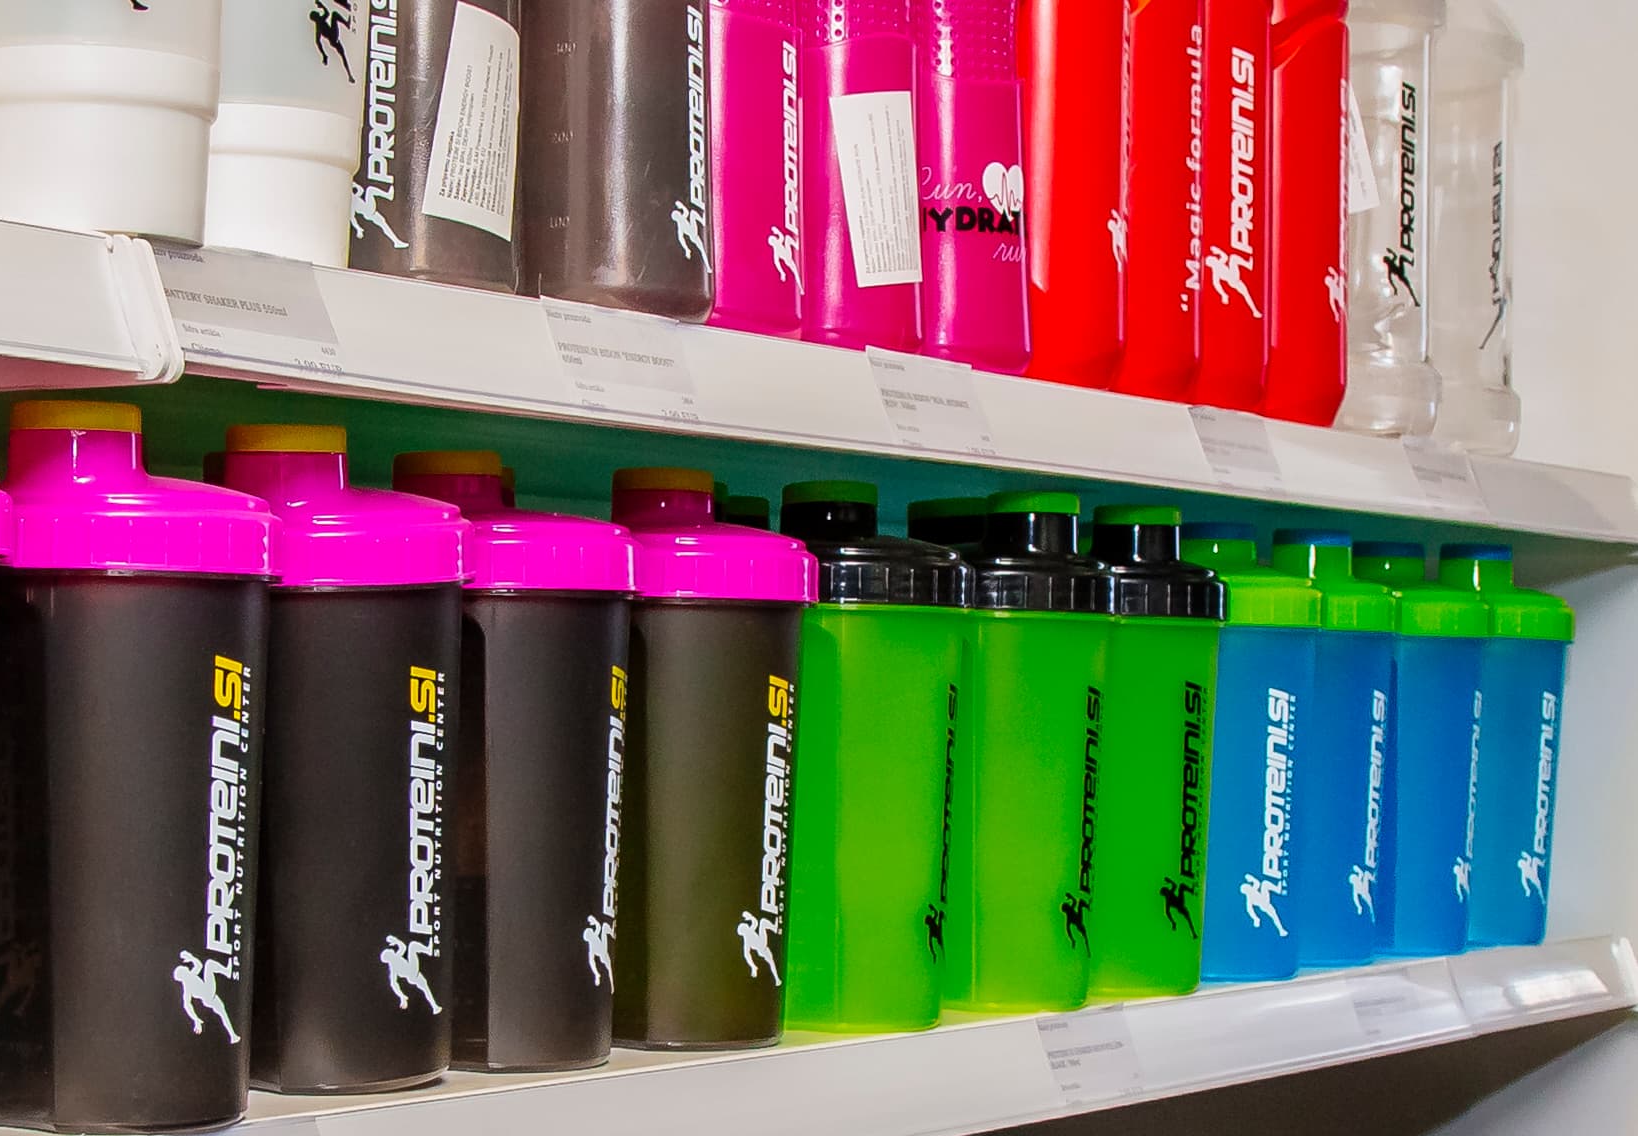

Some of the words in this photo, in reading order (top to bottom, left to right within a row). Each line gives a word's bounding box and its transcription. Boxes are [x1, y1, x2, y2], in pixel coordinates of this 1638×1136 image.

[1186, 24, 1202, 172] formula
[240, 666, 252, 753] CENTER
[436, 672, 446, 751] CENTER
[235, 767, 247, 895] NUTRITION
[434, 765, 444, 880] NUTRITION
[232, 909, 243, 981] SPORT
[433, 893, 442, 957] SPORT
